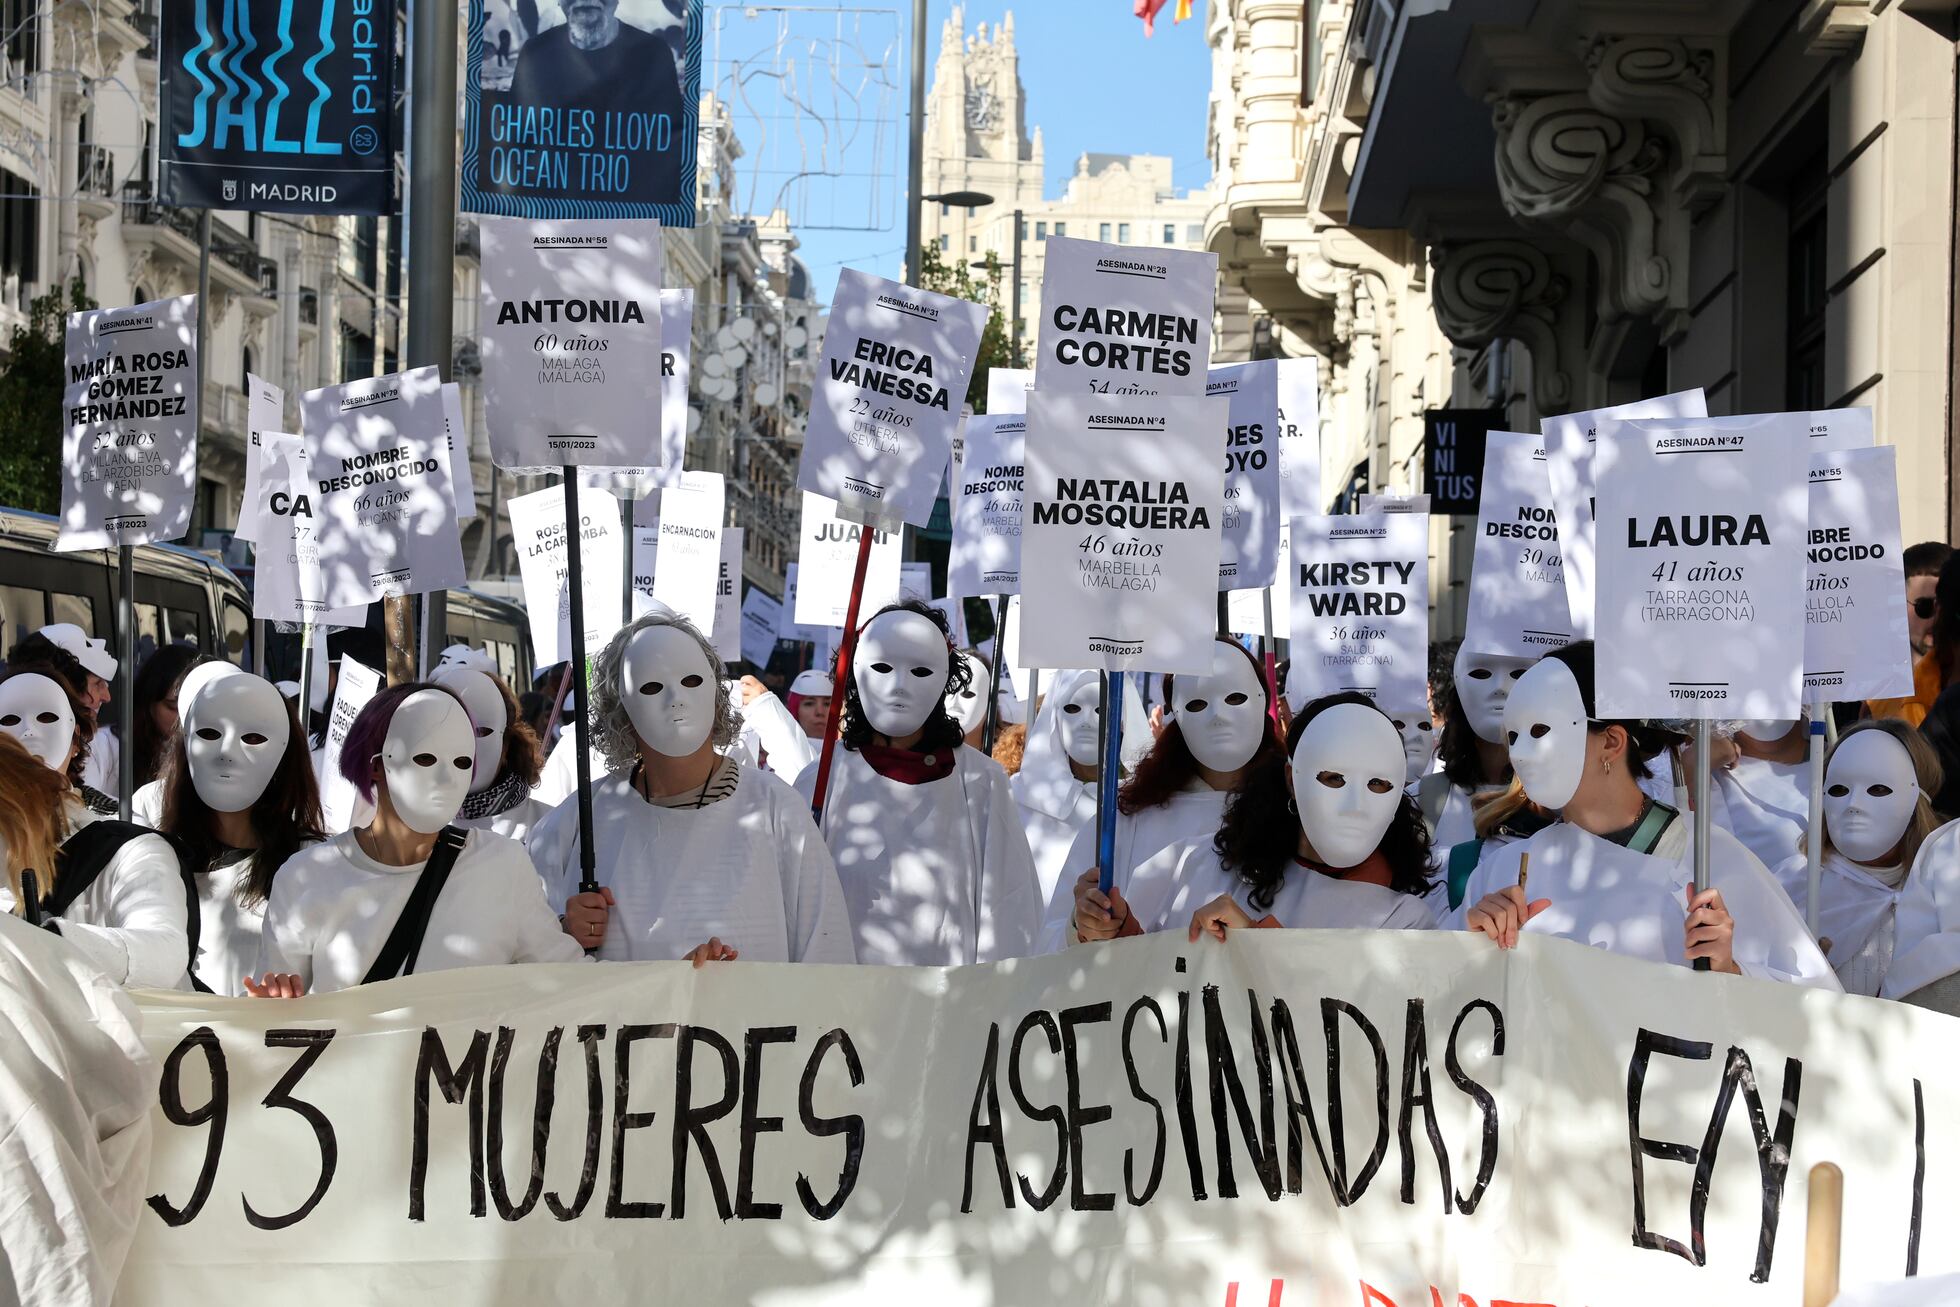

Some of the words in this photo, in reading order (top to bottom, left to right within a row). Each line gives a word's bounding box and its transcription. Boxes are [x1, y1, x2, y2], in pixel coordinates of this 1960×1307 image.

[490, 103, 596, 149] CHARLES
[604, 112, 672, 152] LLOYD
[489, 146, 569, 190] OCEAN
[578, 152, 630, 193] TRIO
[250, 183, 338, 203] MADRID
[533, 236, 585, 245] ASESINADA
[1096, 258, 1146, 273] ASESINADA
[496, 299, 646, 325] ANTONIA
[878, 295, 921, 314] ASESINADA
[100, 318, 136, 332] ASESINADA
[1053, 304, 1199, 345] CARMEN
[533, 333, 558, 352] 60
[563, 333, 610, 352] años
[70, 351, 127, 384] MARÍA
[132, 349, 190, 374] ROSA
[541, 355, 602, 370] MÁLAGA
[853, 336, 934, 379] ERICA
[1055, 338, 1192, 377] CORTÉS
[87, 368, 164, 400] GÓMEZ
[537, 368, 606, 385] (MÁLAGA)
[829, 357, 950, 412] VANESSA
[1087, 378, 1111, 394] 54
[70, 393, 187, 427] FERNÁNDEZ
[340, 393, 381, 407] ASESINADA
[848, 397, 871, 414] 22
[872, 405, 914, 429] años
[1087, 415, 1145, 426] ASESINADA
[93, 430, 111, 451] 52
[116, 429, 157, 447] años
[853, 420, 900, 442] UTRERA
[1434, 422, 1458, 448] VI
[547, 440, 596, 450] 15/01/2023
[847, 431, 901, 456] (SEVILLA)
[1655, 436, 1716, 449] ASESINADA
[89, 451, 161, 470] VILLANUEVA
[341, 446, 411, 473] NOMBRE
[1434, 449, 1457, 473] NI
[81, 469, 101, 484] DEL
[103, 464, 172, 480] ARZOBISPO
[318, 457, 440, 495] DESCONOCIDO
[105, 477, 142, 495] (JAÉN)
[843, 481, 882, 499] 31/07/2023
[1056, 478, 1190, 505] NATALIA
[1434, 474, 1476, 501] TUS
[352, 494, 373, 513] 66
[375, 487, 411, 508] años
[983, 500, 999, 513] 46
[105, 520, 148, 532] 0309/2023
[356, 507, 412, 529] ALICANTE
[1032, 502, 1211, 530] MOSQUERA
[291, 526, 311, 541] 27
[535, 515, 592, 541] ROSAO
[1626, 513, 1772, 549] LAURA
[528, 543, 544, 558] LA
[544, 525, 609, 552] CARMBA
[1078, 534, 1106, 555] 46
[1111, 536, 1164, 558] años
[1519, 548, 1541, 565] 30
[1078, 558, 1162, 578] MARBELLA
[1299, 561, 1418, 588] KIRSTY
[1651, 561, 1678, 583] 41
[1687, 560, 1745, 583] años
[983, 575, 1019, 584] 28/04/2023
[1081, 570, 1157, 593] (MÁLAGA)
[1308, 592, 1407, 617] WARD
[1645, 589, 1751, 606] TARRAGONA
[1640, 605, 1756, 623] (TARRAGONA)
[1329, 625, 1348, 641] 36
[1351, 624, 1387, 641] años
[1522, 635, 1569, 647] 24/10/2023
[1088, 642, 1144, 656] 08/01/2023
[1339, 644, 1376, 655] SALOU
[1322, 655, 1394, 668] (TARRAGONA)
[1668, 688, 1729, 700] 17/09/2023
[145, 1025, 339, 1232] 93
[408, 1022, 866, 1226] MUJERES
[959, 956, 1507, 1217] ASESINADAS
[1630, 1026, 1803, 1285] EN
